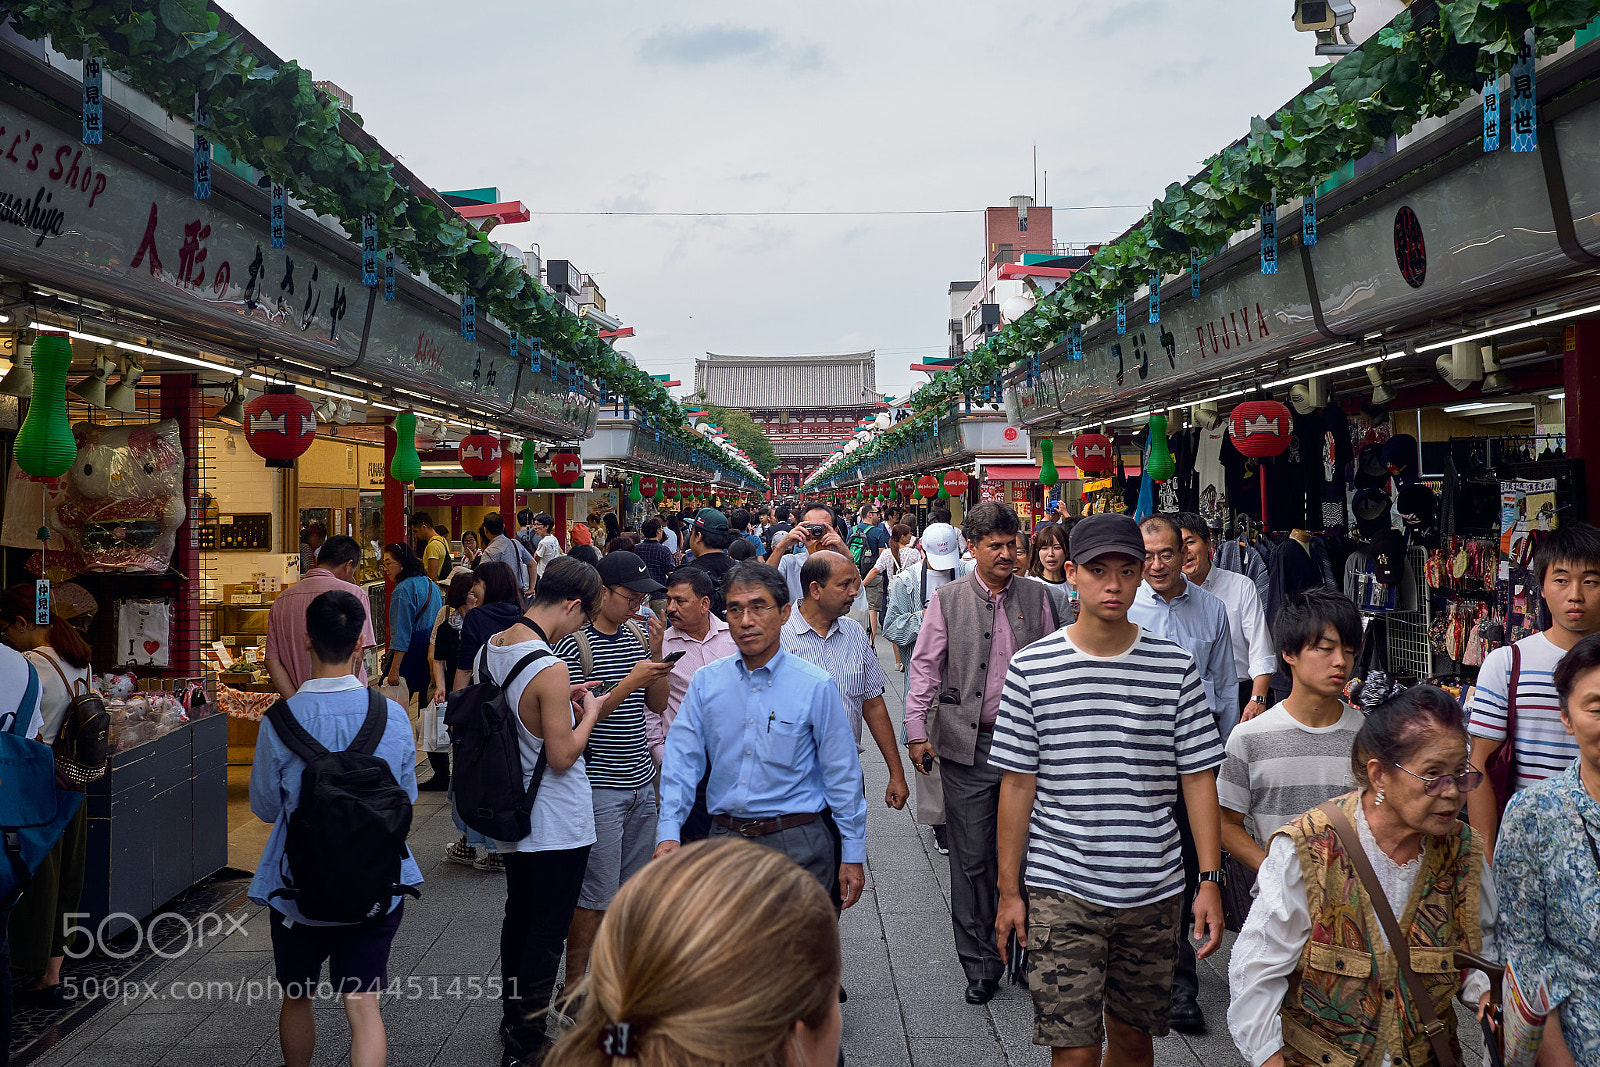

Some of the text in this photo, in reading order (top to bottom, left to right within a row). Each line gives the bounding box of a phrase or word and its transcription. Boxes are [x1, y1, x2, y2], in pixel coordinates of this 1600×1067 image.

[84, 58, 101, 132] 仲見世
[48, 145, 107, 208] Shop
[273, 184, 284, 239] 仲見世
[1262, 203, 1275, 263] 仲見世
[364, 215, 376, 273] 仲見世
[385, 251, 394, 293] 仲見世
[1073, 327, 1081, 351] 見世
[1111, 325, 1176, 386] フジヤ
[1196, 302, 1270, 359] FUJIYA
[37, 583, 49, 624] 仲見世
